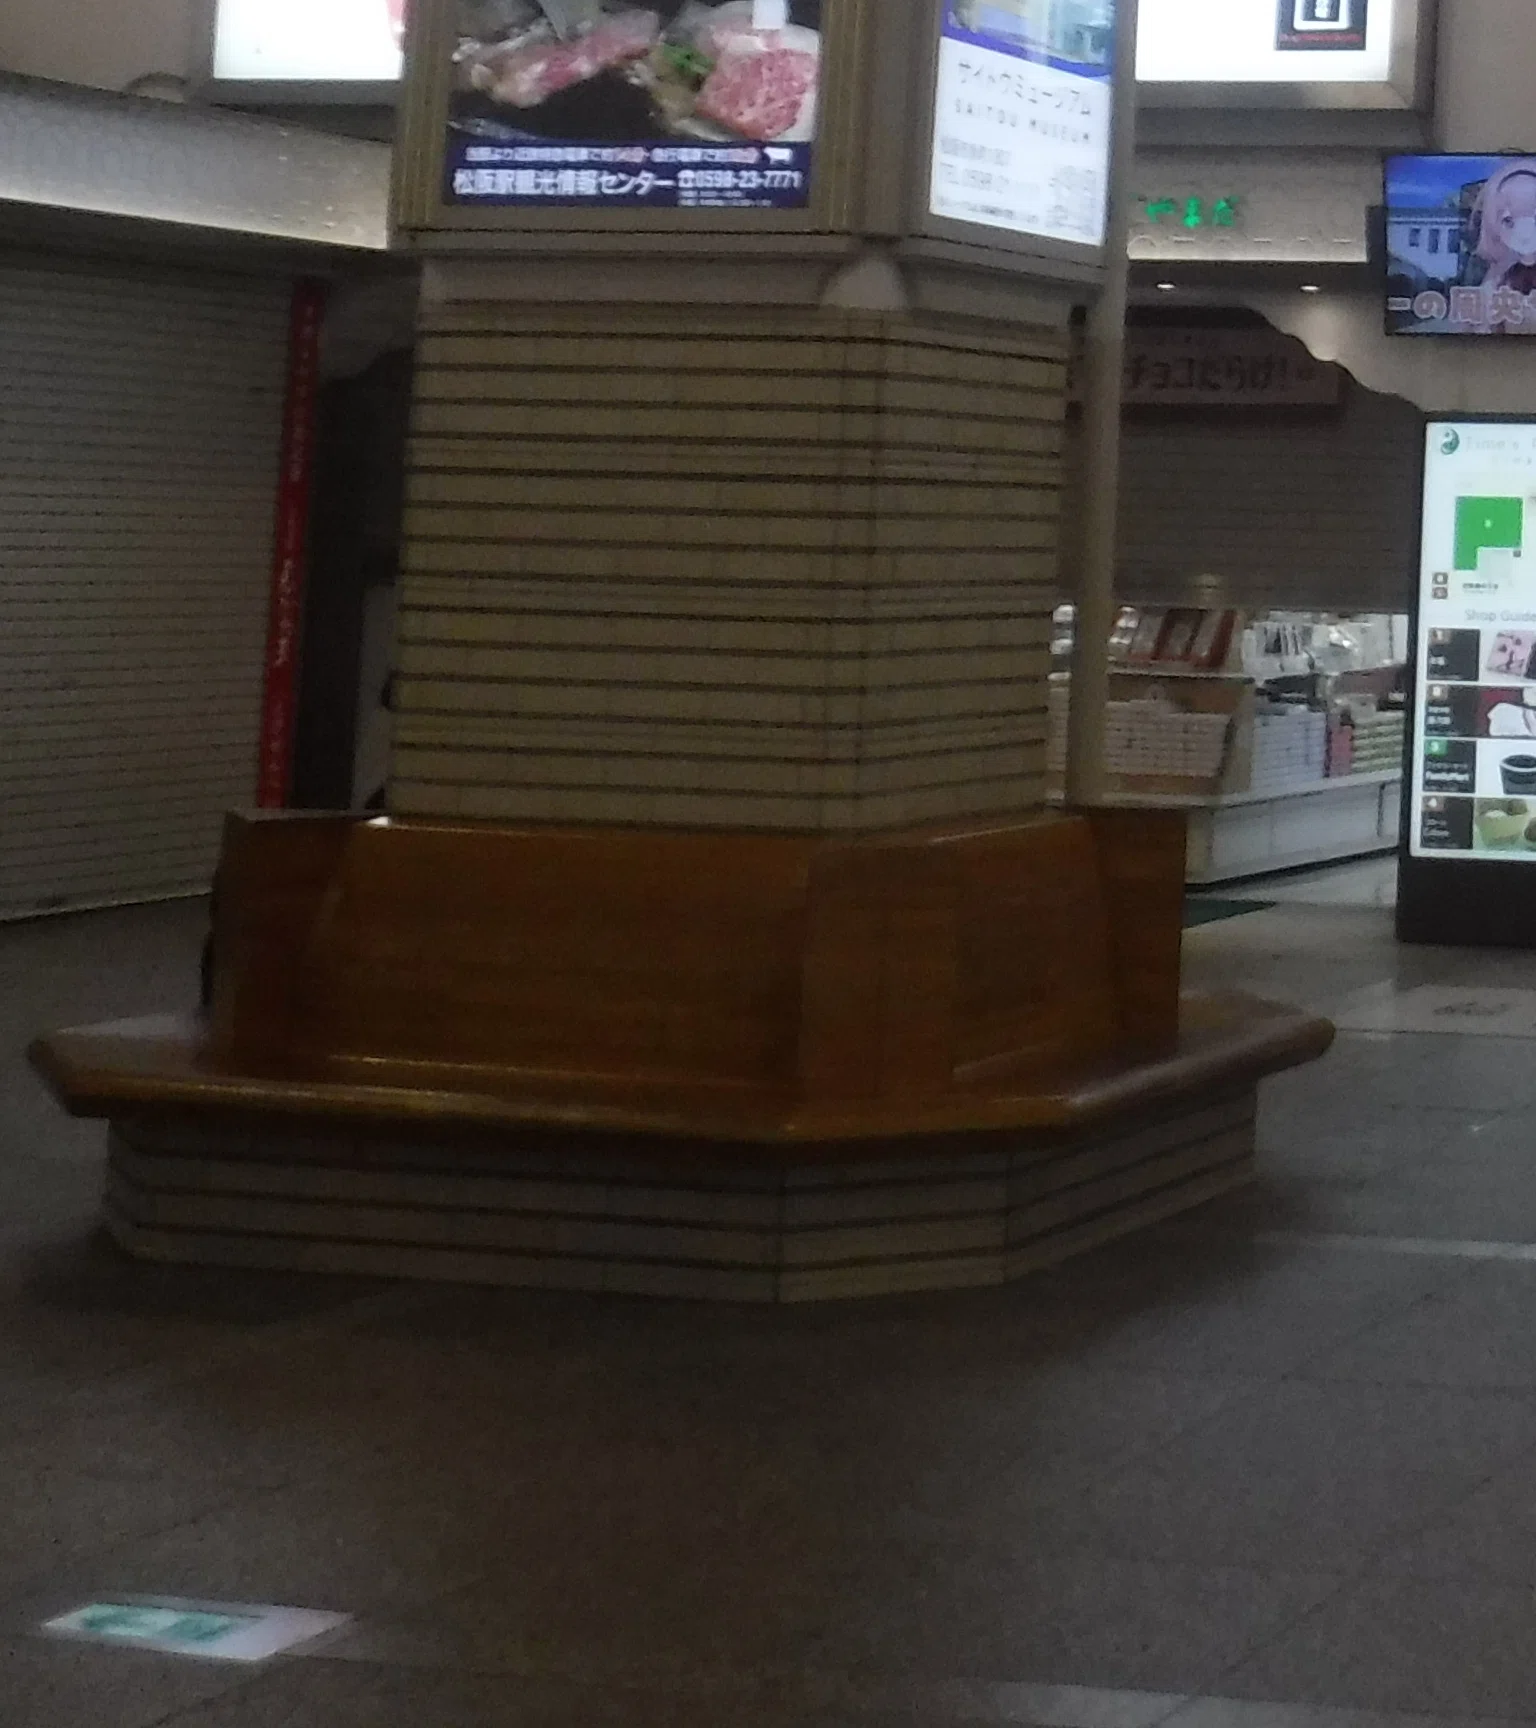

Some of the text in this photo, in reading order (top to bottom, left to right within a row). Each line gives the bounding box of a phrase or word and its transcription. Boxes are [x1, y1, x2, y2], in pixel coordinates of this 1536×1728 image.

[958, 61, 1091, 116] サイトウミュージアム
[1465, 608, 1496, 626] Shop
